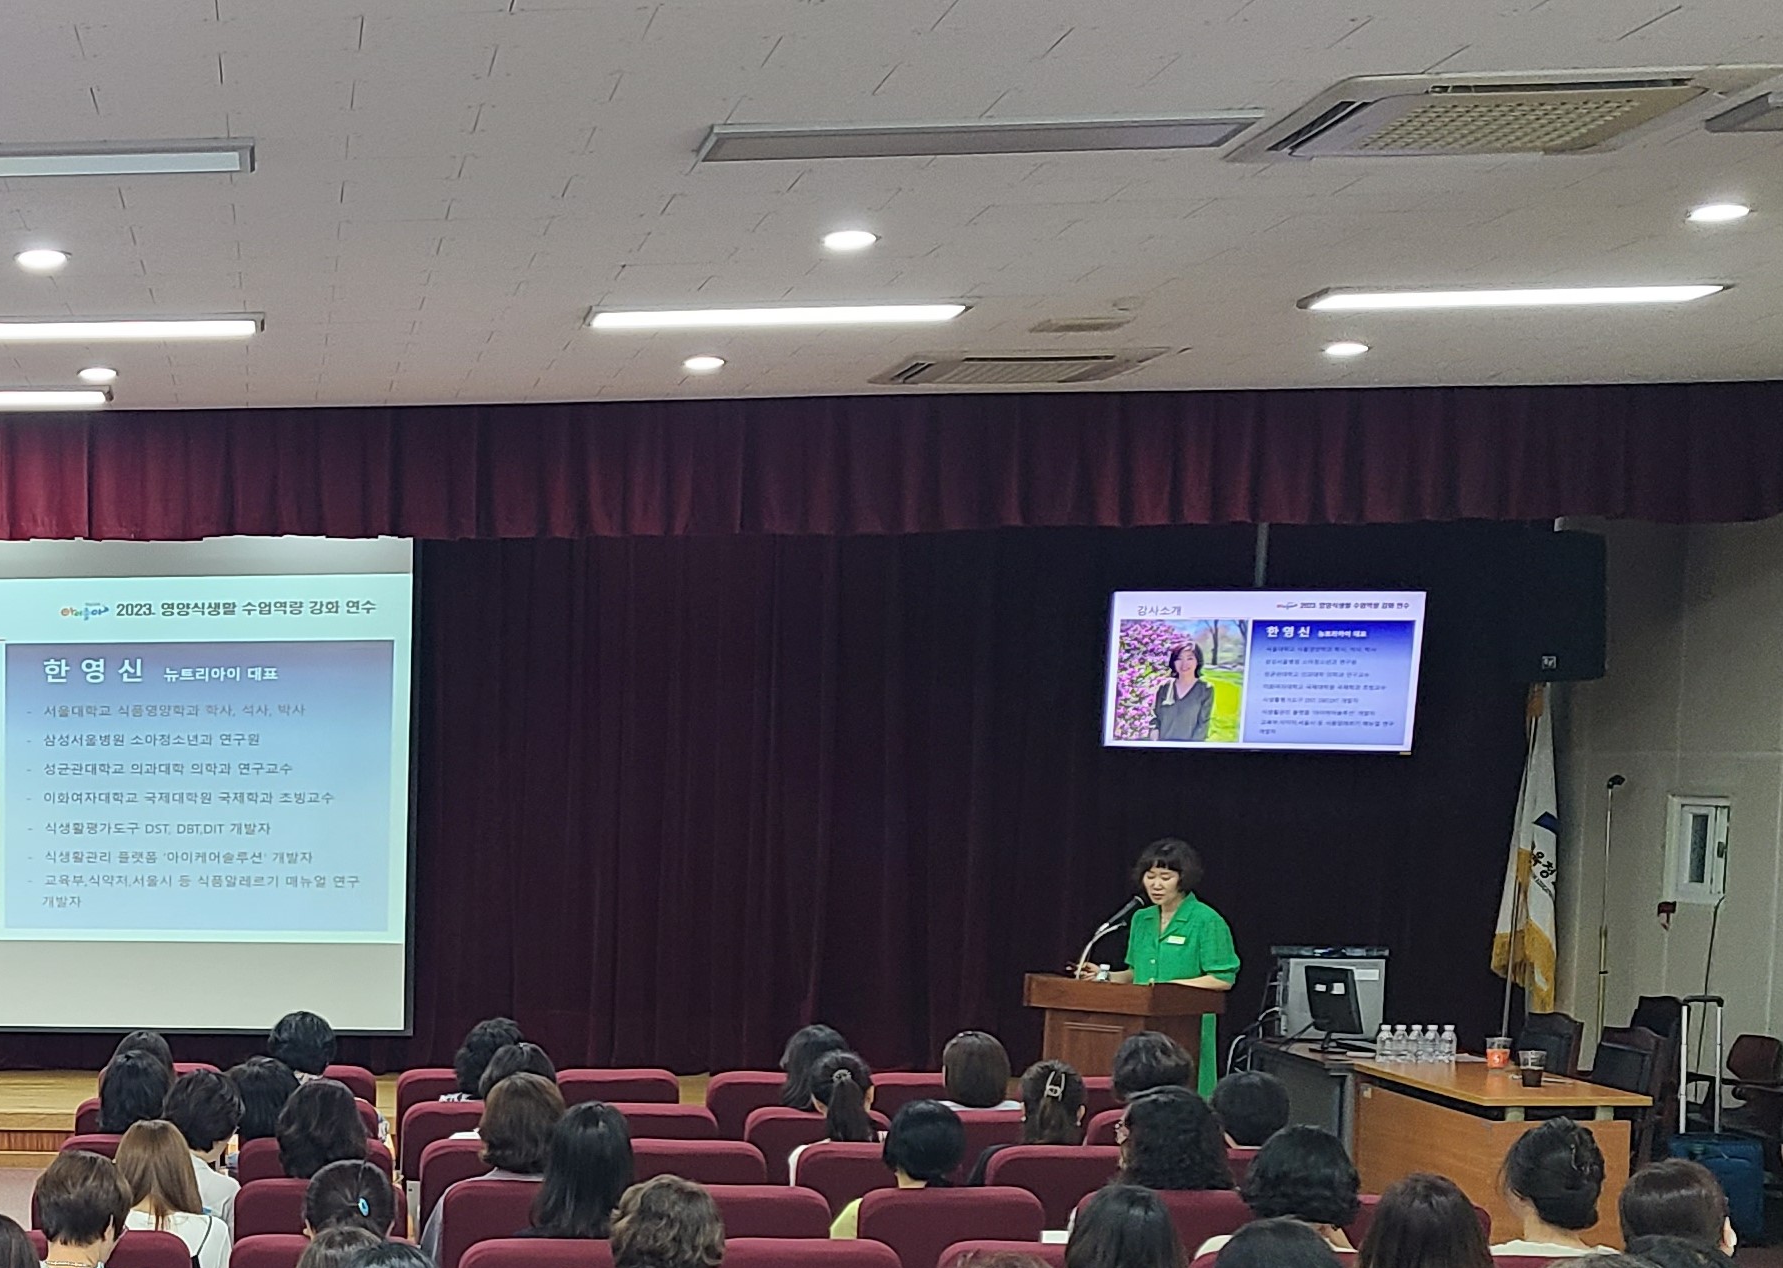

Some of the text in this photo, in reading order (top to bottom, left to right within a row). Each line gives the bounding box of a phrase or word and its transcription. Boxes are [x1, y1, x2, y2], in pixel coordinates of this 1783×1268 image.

[116, 600, 377, 617] 2023. 영양식생활 수업역량 강화 연수
[43, 658, 279, 683] 한 영 신 뉴트리아이 대표
[43, 705, 112, 718] 서울대학교
[118, 704, 199, 718] 식품영양학과
[277, 704, 306, 717] 박사
[43, 733, 260, 747] 삼성서울병원 소아청소년과 연구원
[44, 762, 293, 776] 성균관대학교 의과대학 의학과 연구교수
[43, 791, 334, 805] 이화여자대학교 국제대학원 국제학과 초빙교수
[45, 822, 140, 835] 식생활평가도구
[230, 822, 271, 836] 개발자
[45, 850, 111, 864] 식생활관리
[118, 851, 158, 864] 플랫폼
[272, 851, 313, 864] 개발자
[178, 874, 191, 888] 등
[197, 874, 279, 888] 식품알레르기
[285, 875, 326, 889] 매뉴얼
[332, 875, 360, 889] 연구
[42, 895, 82, 908] 개발자
